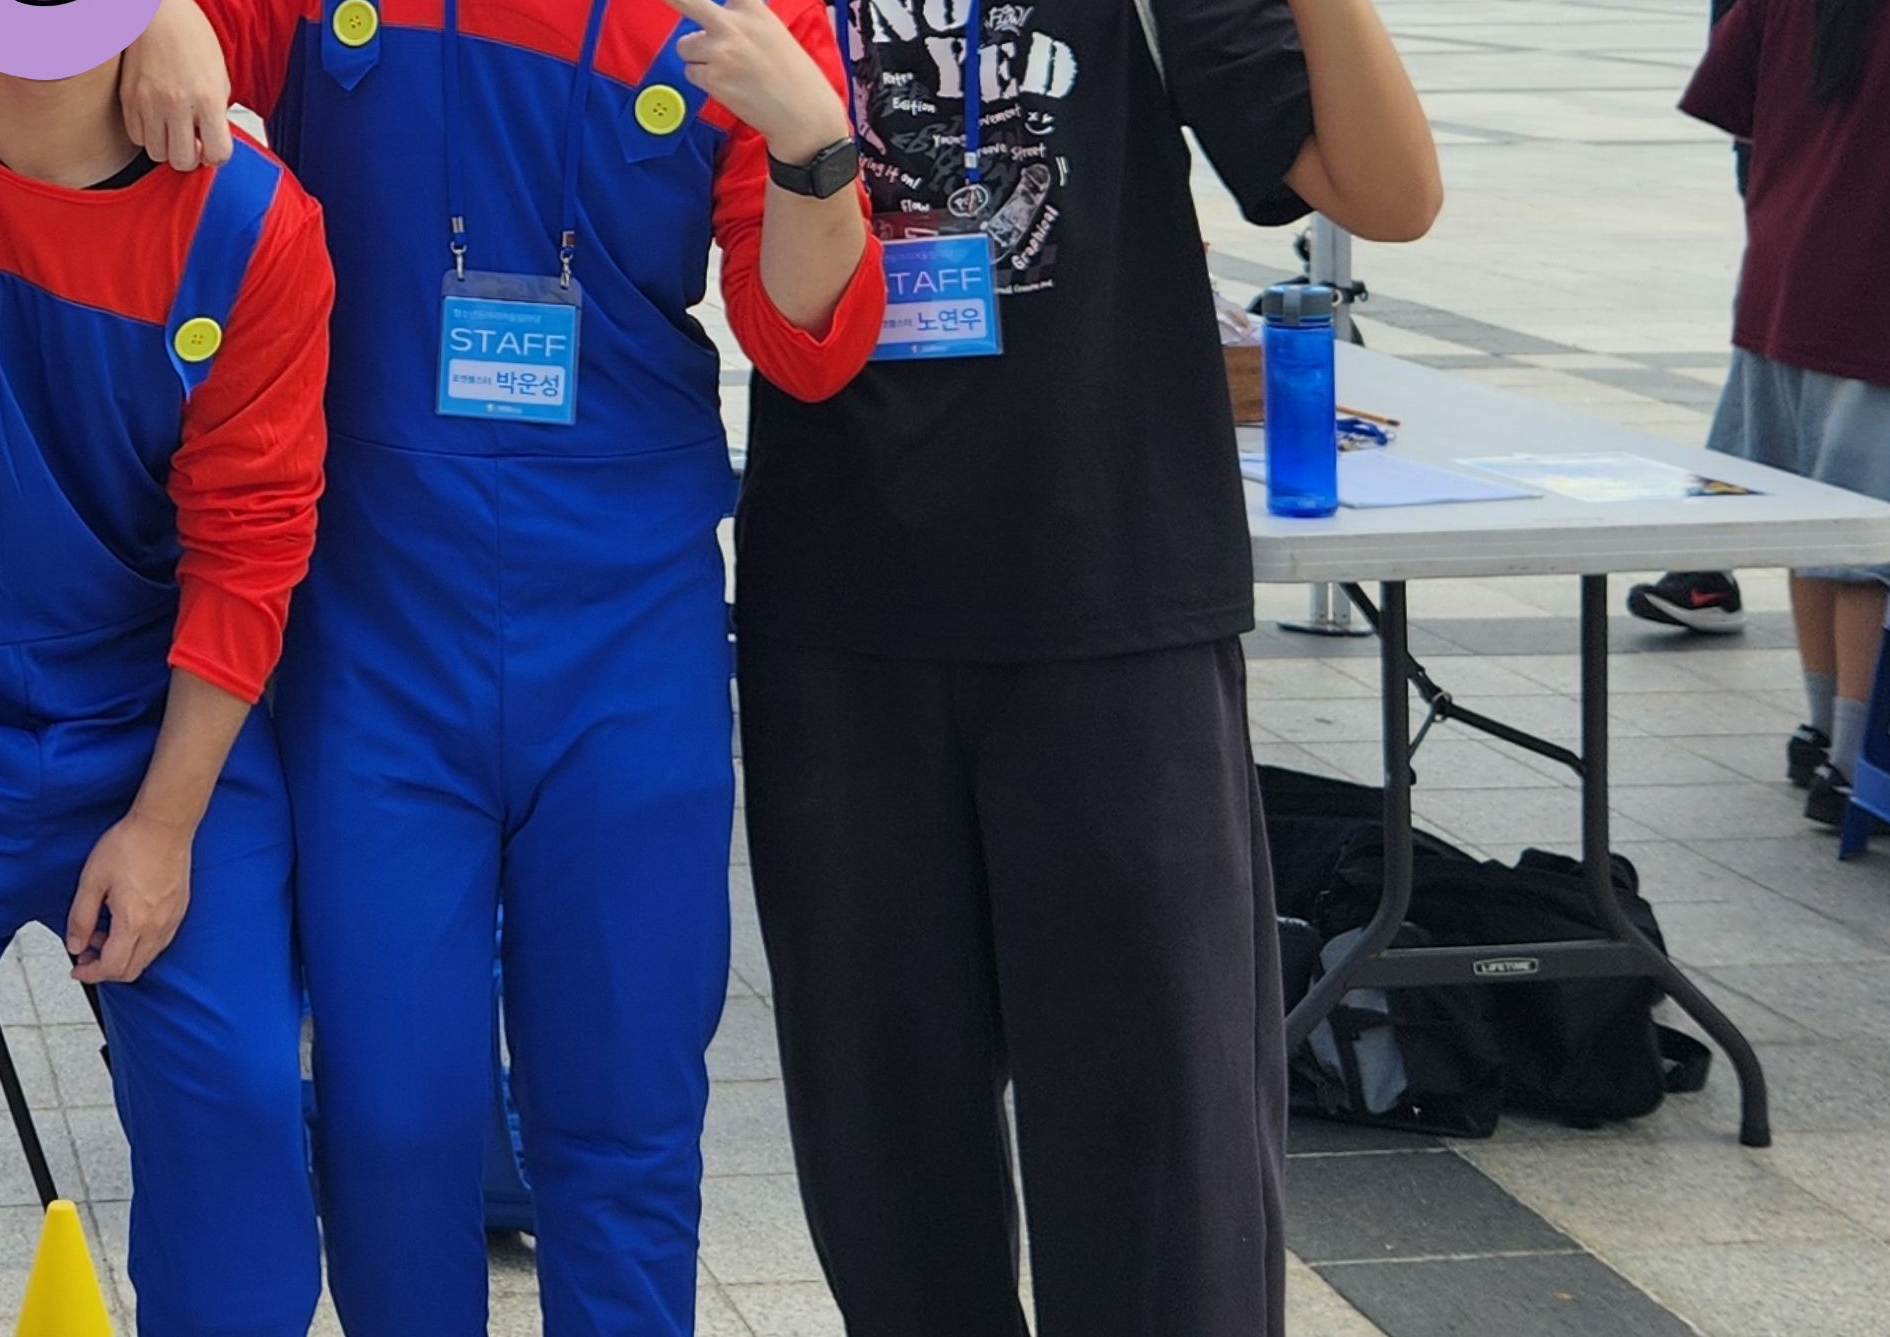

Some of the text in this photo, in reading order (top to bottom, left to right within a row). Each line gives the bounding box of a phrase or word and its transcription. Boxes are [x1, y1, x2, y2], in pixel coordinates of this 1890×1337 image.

[976, 144, 1007, 157] roove
[1011, 204, 1059, 270] Graphical
[889, 266, 982, 295] TAFF
[917, 307, 982, 332] 노연우
[450, 327, 567, 358] STAFF
[497, 370, 559, 397] 박운성
